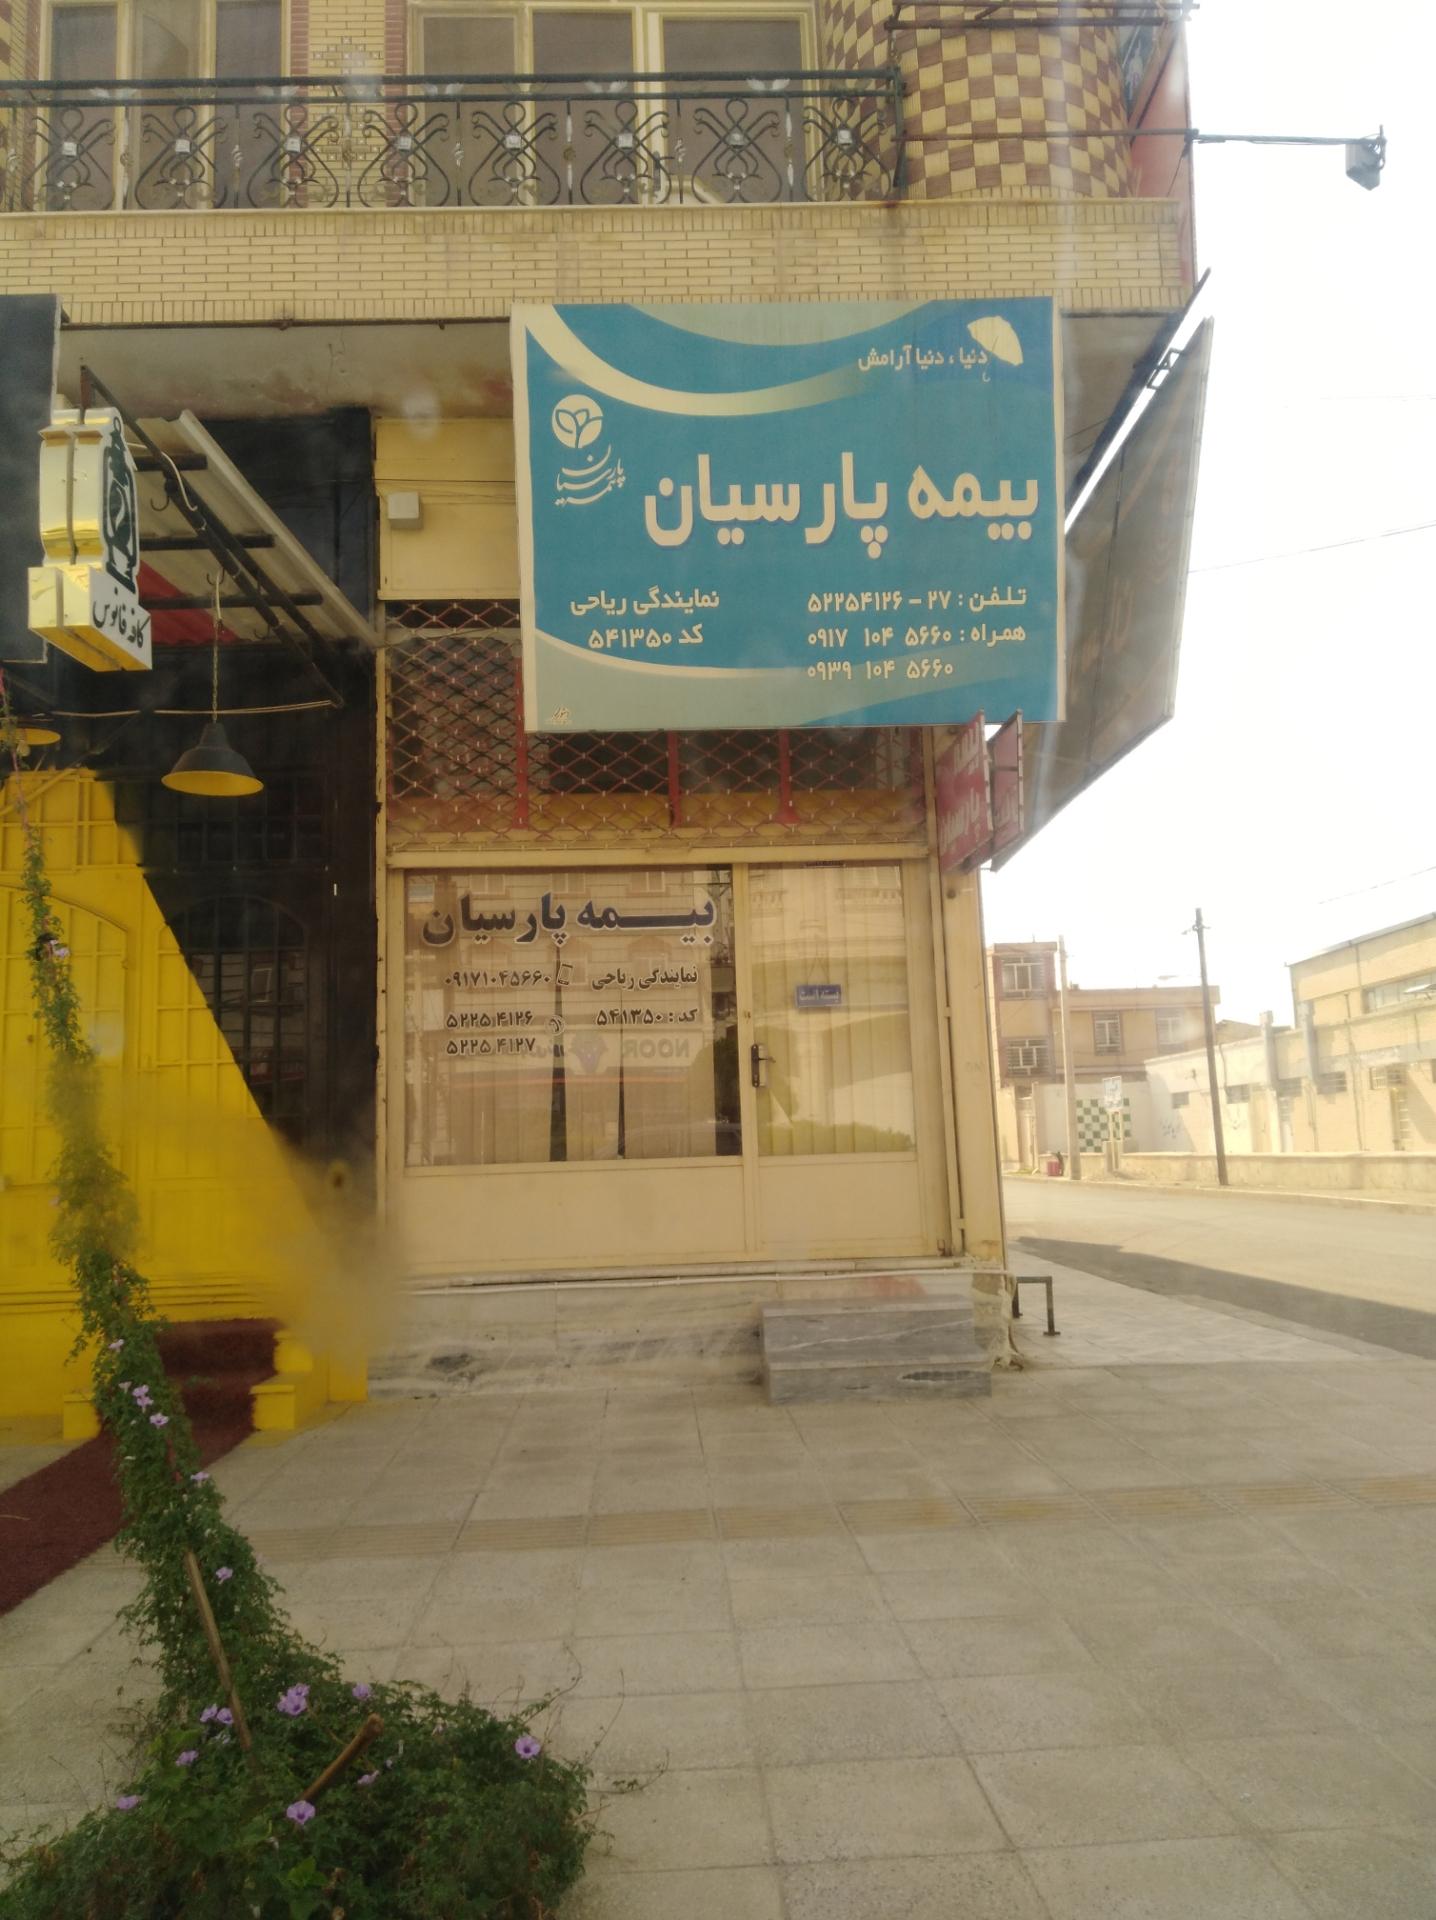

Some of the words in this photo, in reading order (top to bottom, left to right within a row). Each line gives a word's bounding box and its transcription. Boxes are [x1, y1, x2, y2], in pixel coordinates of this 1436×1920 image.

[858, 345, 912, 371] آرامش
[915, 347, 944, 370] دنیا
[644, 452, 889, 560] پارسیان
[907, 465, 1039, 541] بیمه
[92, 586, 127, 635] فانوس
[570, 590, 627, 616] ریاحی
[633, 585, 720, 615] نمایندگی
[807, 591, 903, 612] ۵۲۲۵۴۱۲۶
[928, 591, 951, 610] ۲۷
[588, 628, 672, 649] ۵۴۱۳۵۰
[678, 624, 704, 644] کد
[807, 628, 848, 648] ۰۹۱۷
[864, 627, 894, 647] ۱۰۴
[905, 626, 952, 646] ۵۶۶۰
[807, 661, 852, 680] ۰۹۳۹
[866, 660, 895, 679] ۱۰۴
[906, 659, 953, 679] ۵۶۶۰
[422, 892, 566, 945] پارسیان
[576, 898, 717, 944] بیمه
[445, 970, 550, 987] ۰۹۱۷۱۰۴۵۶۶۰
[591, 967, 634, 991] ریاحی
[596, 1008, 662, 1025] ۵۴۱۳۵۰
